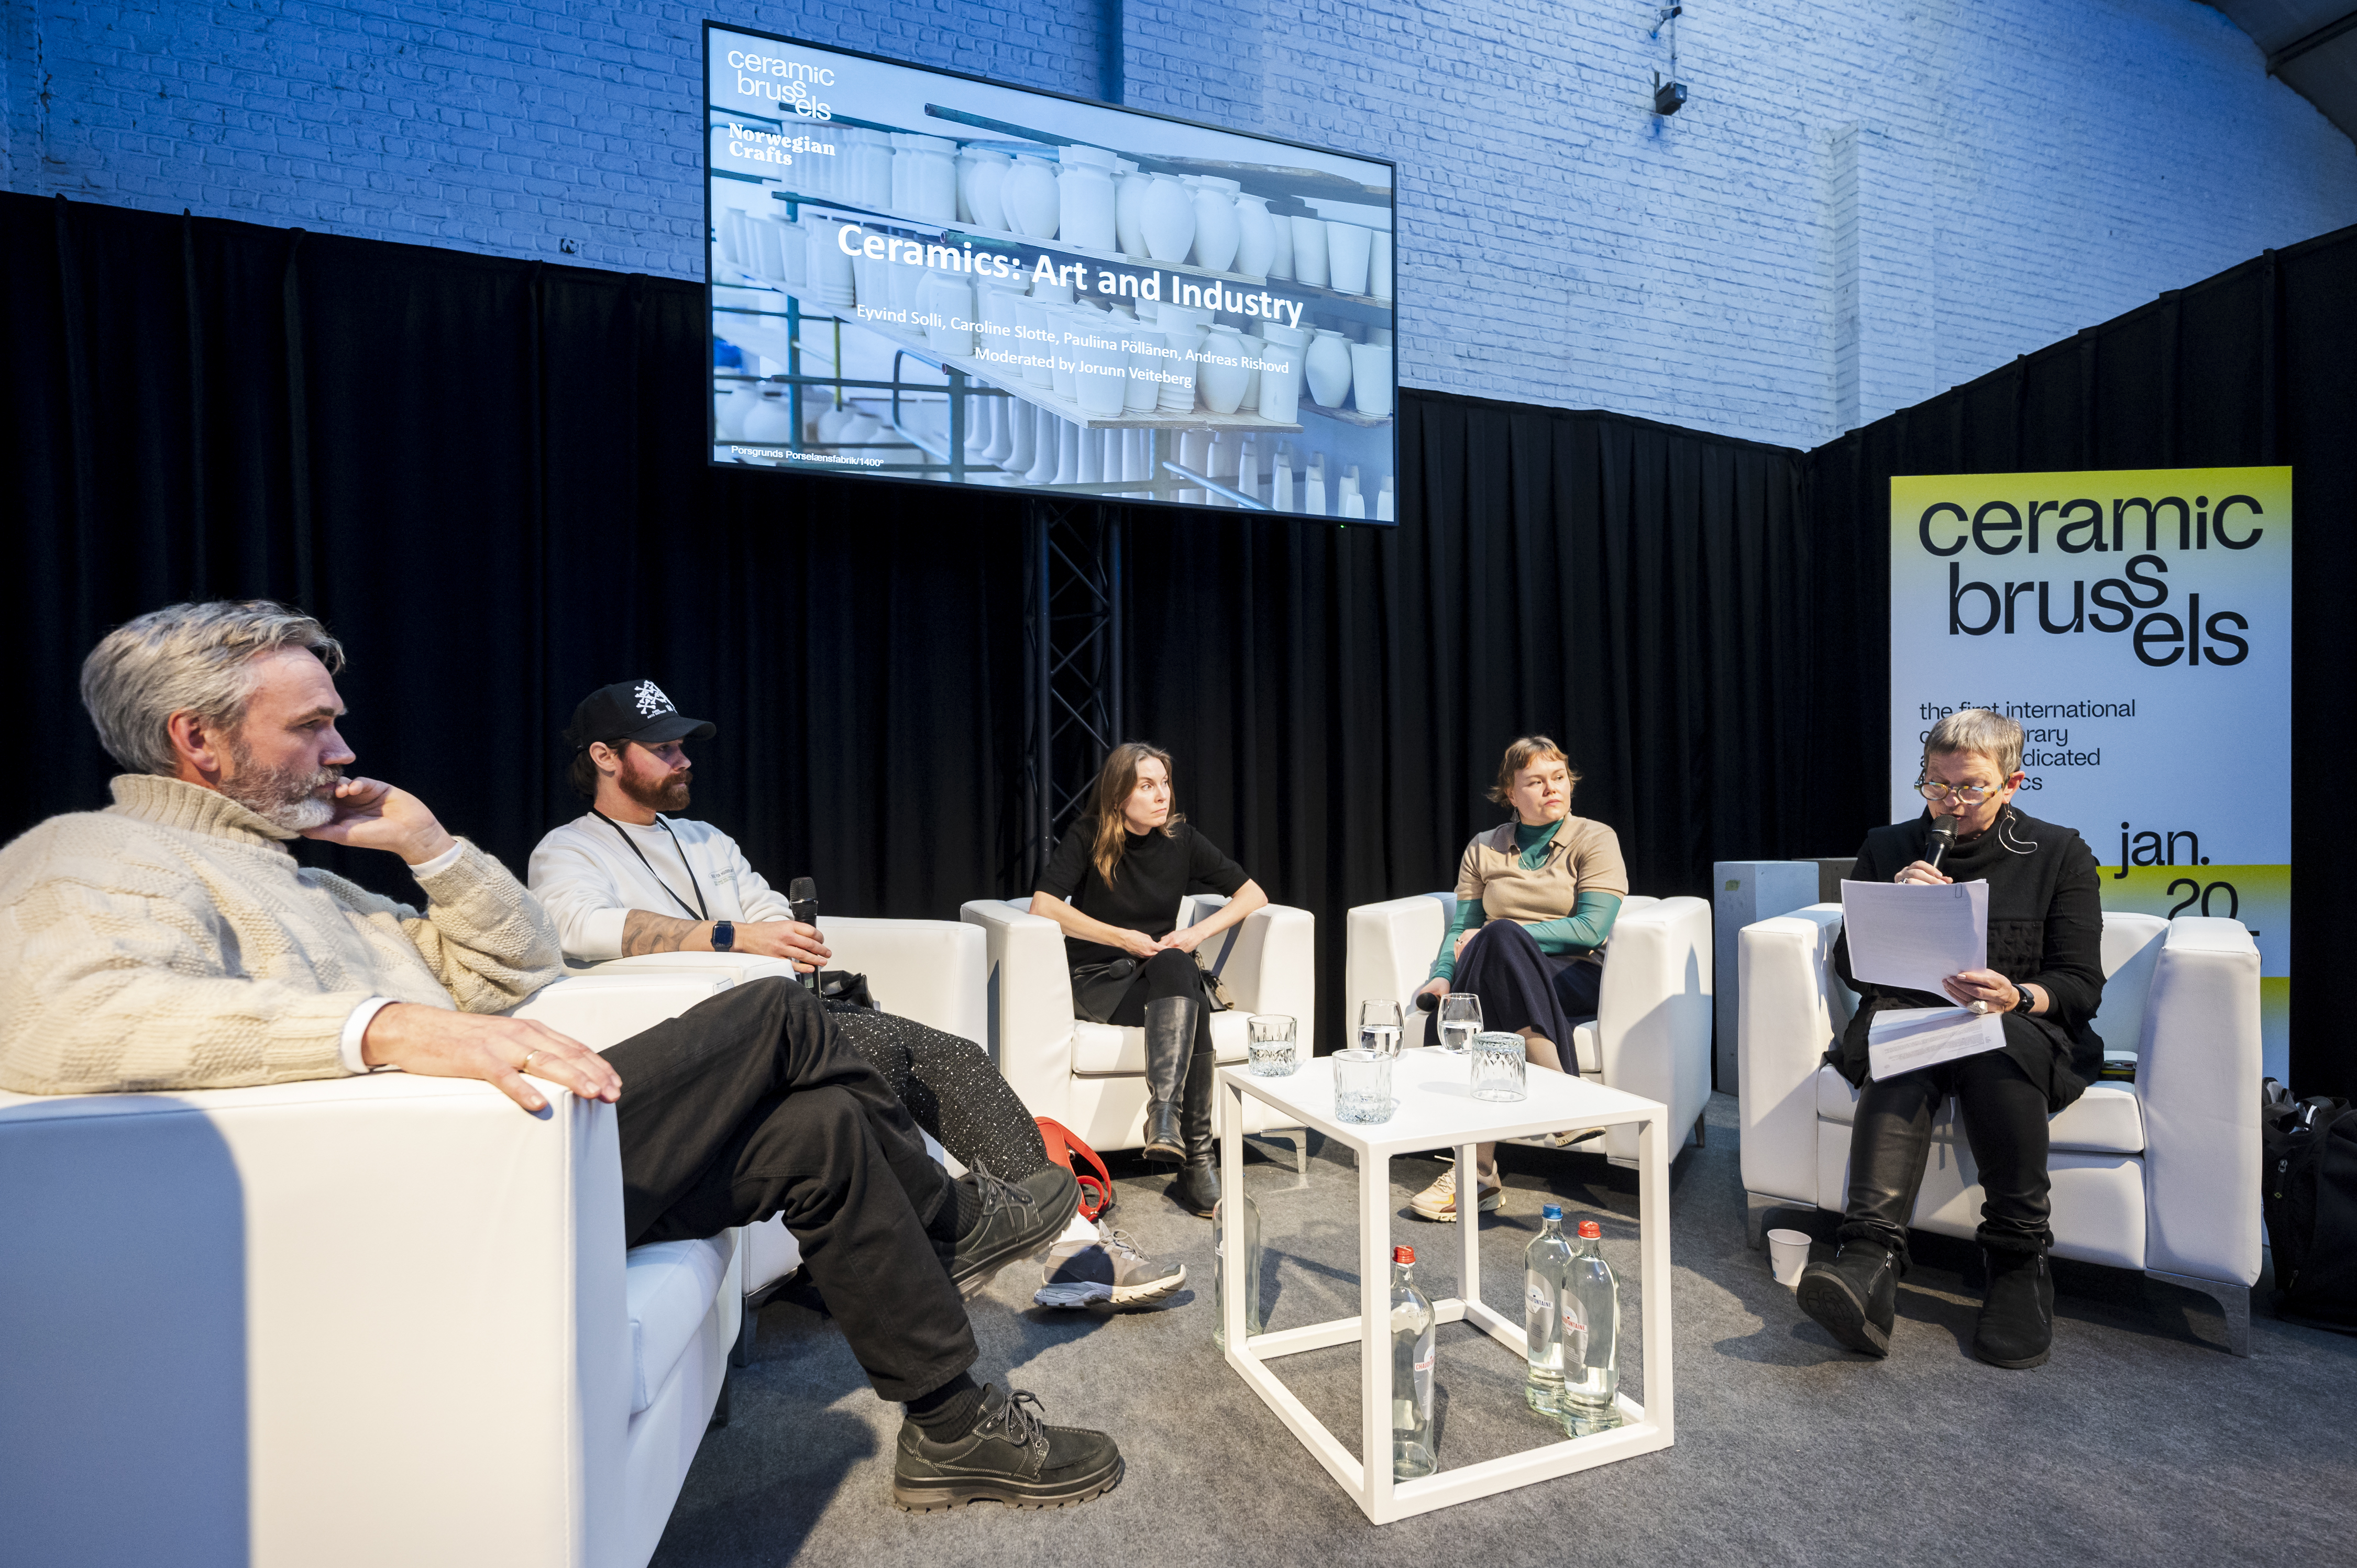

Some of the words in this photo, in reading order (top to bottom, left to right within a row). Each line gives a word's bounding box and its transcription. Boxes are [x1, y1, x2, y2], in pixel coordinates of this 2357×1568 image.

[728, 50, 835, 86] ceramic
[737, 70, 832, 120] brussels
[728, 122, 835, 156] Norwegian
[729, 140, 792, 165] Crafts
[838, 224, 1020, 280] Ceramics:
[1032, 255, 1087, 291] Art
[1098, 271, 1160, 301] and
[1173, 275, 1303, 328] Industry
[857, 304, 907, 323] Eyvind
[911, 311, 946, 331] Solli,
[951, 317, 1010, 337] Caroline
[1015, 325, 1059, 346] Slotte,
[1064, 332, 1117, 351] Pauliina
[1121, 339, 1182, 362] Pöllänen,
[1185, 349, 1238, 367] Andreas
[1241, 356, 1289, 374] Rishovd
[975, 347, 1055, 369] Moderated
[1059, 356, 1076, 374] by
[1078, 361, 1126, 378] Jorunn
[1128, 367, 1192, 389] Veiteberg
[731, 445, 784, 458] Porsgrunds
[1919, 494, 2263, 556] ceramic
[1950, 554, 2249, 667] brussels
[1920, 702, 1953, 720] the
[2006, 699, 2135, 718] international
[2022, 748, 2100, 766] dicated
[2114, 822, 2210, 879] jan.
